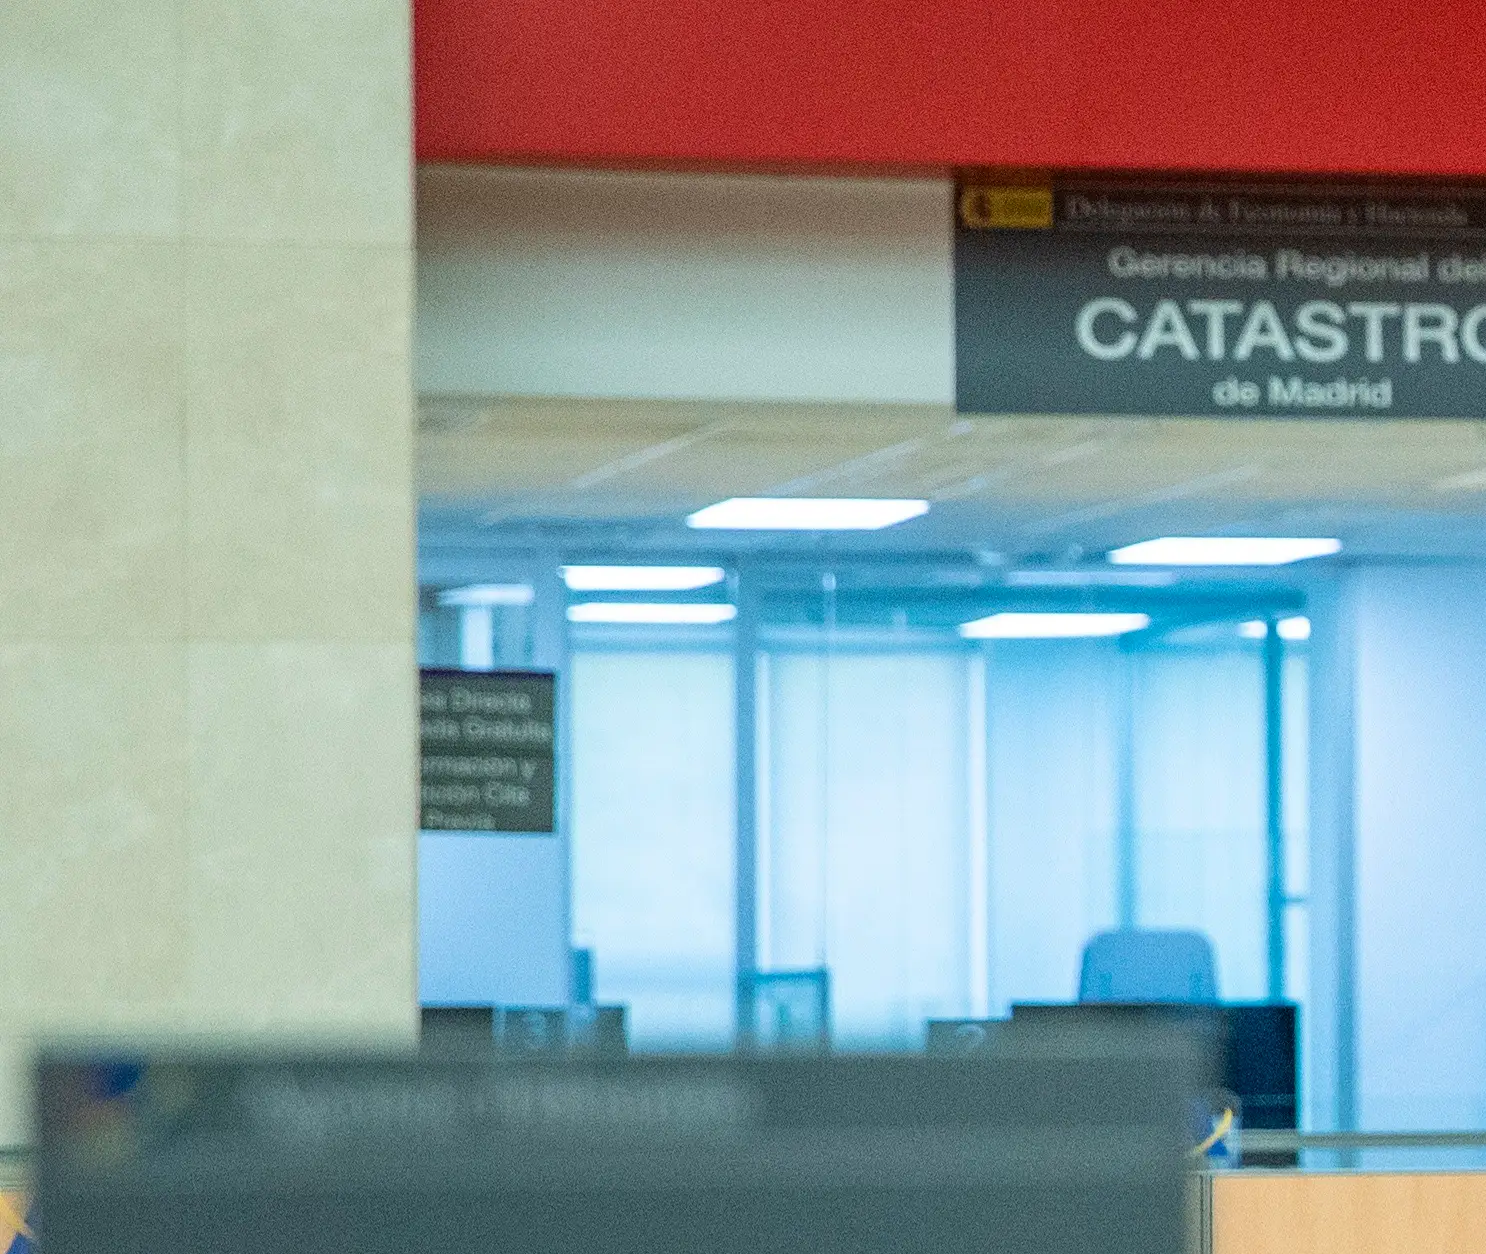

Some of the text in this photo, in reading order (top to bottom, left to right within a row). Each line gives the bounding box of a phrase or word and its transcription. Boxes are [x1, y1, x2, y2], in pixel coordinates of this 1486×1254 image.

[1107, 247, 1268, 281] Gerencia
[1275, 249, 1430, 287] Regional
[1212, 375, 1393, 409] de Madrid
